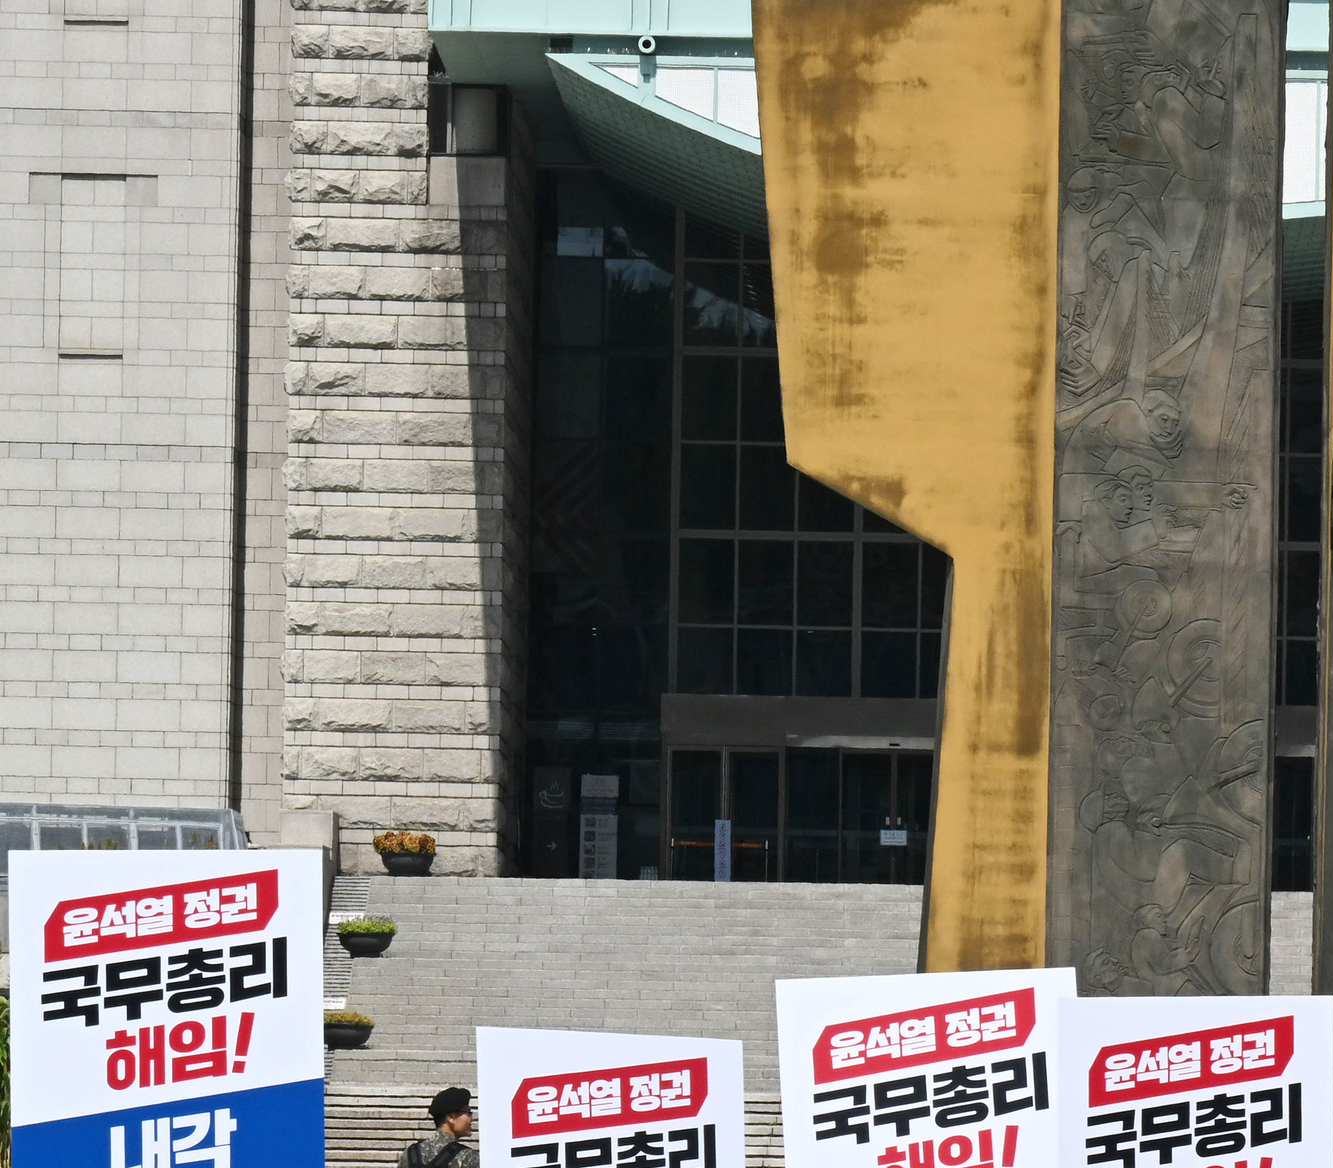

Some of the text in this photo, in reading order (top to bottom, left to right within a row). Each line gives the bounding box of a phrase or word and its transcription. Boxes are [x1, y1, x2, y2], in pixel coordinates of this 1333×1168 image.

[64, 883, 256, 947] 윤석열 정권
[41, 937, 287, 1027] 국무총리
[107, 1013, 254, 1090] 해임!
[831, 1001, 1016, 1068] 윤석열 정권
[1105, 1029, 1274, 1092] 윤석열 정권
[529, 1070, 690, 1123] 윤석열 정권
[813, 1052, 1048, 1144] 국무총리
